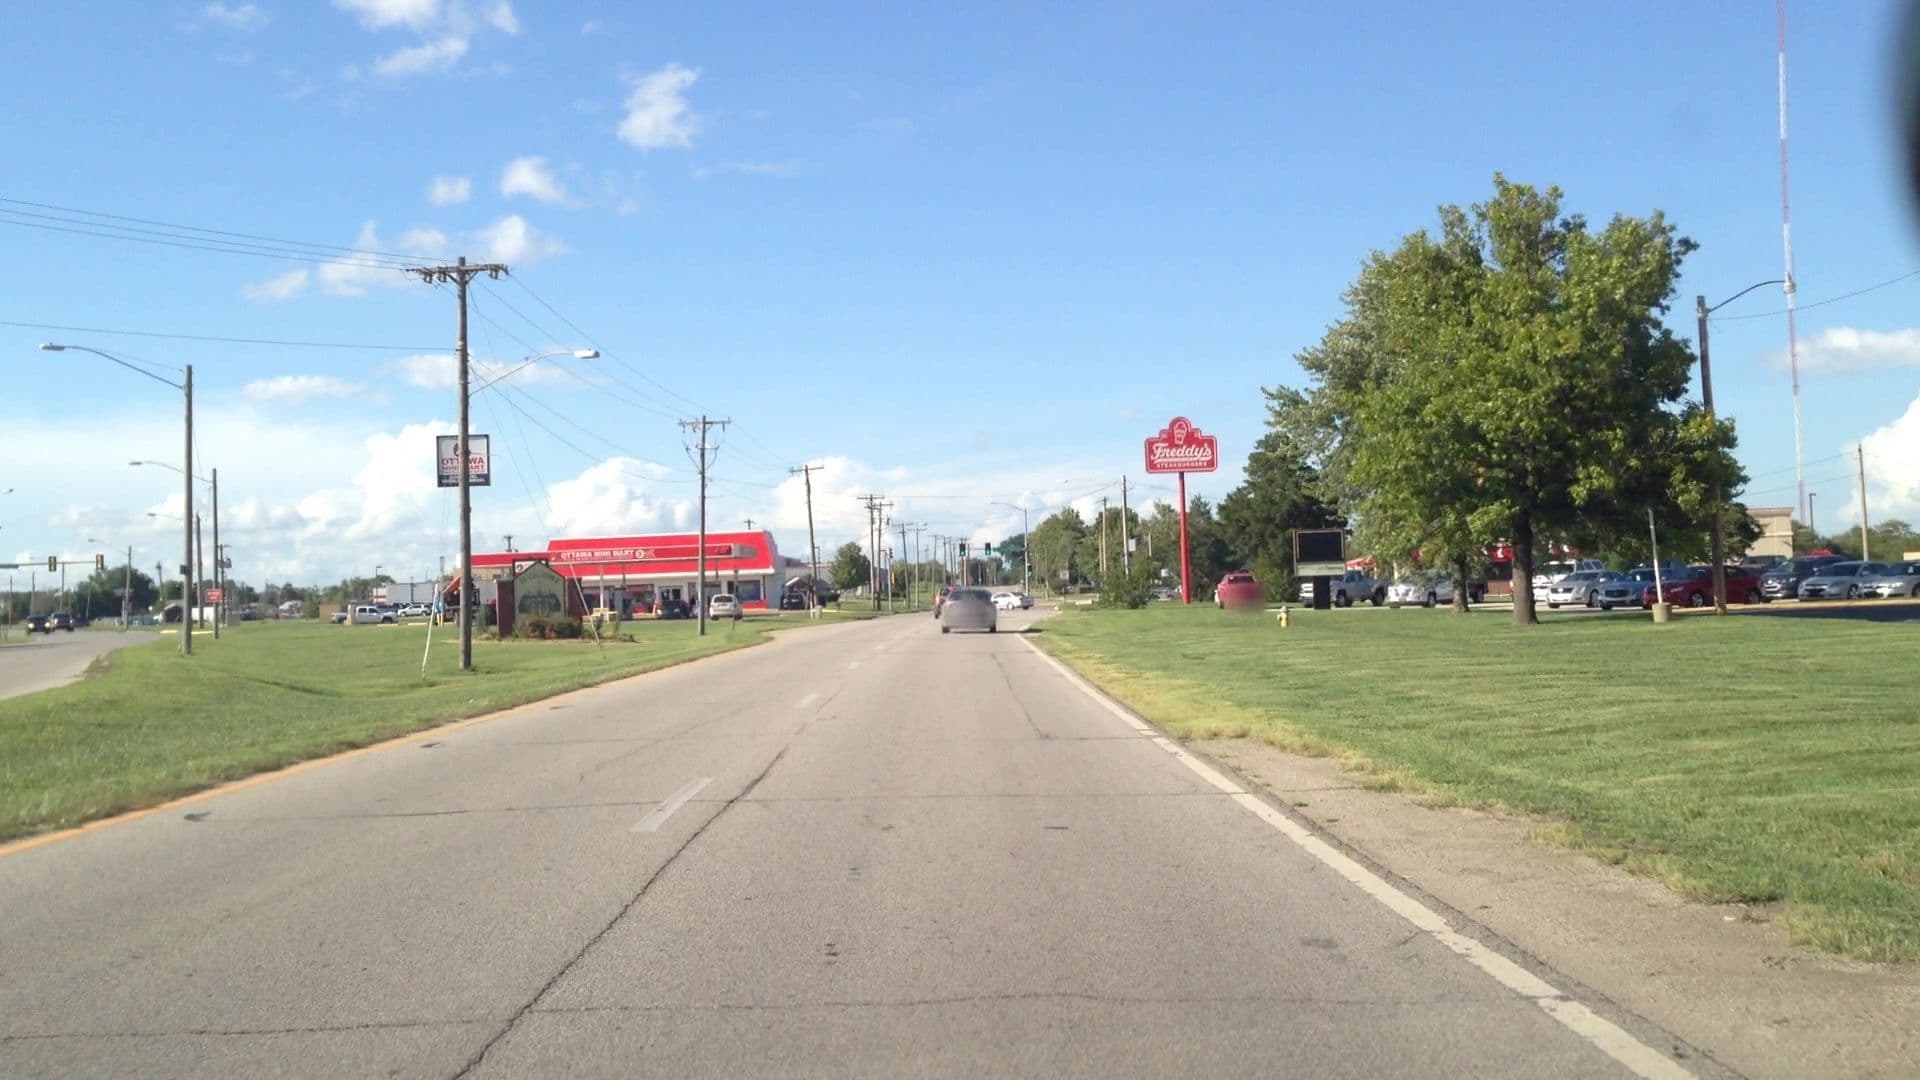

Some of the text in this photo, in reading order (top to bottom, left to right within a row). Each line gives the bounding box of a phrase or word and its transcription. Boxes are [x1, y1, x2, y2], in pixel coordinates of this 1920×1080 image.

[1151, 443, 1212, 461] Freddy's
[441, 457, 484, 465] OTTWA
[560, 551, 593, 559] OTTAWA
